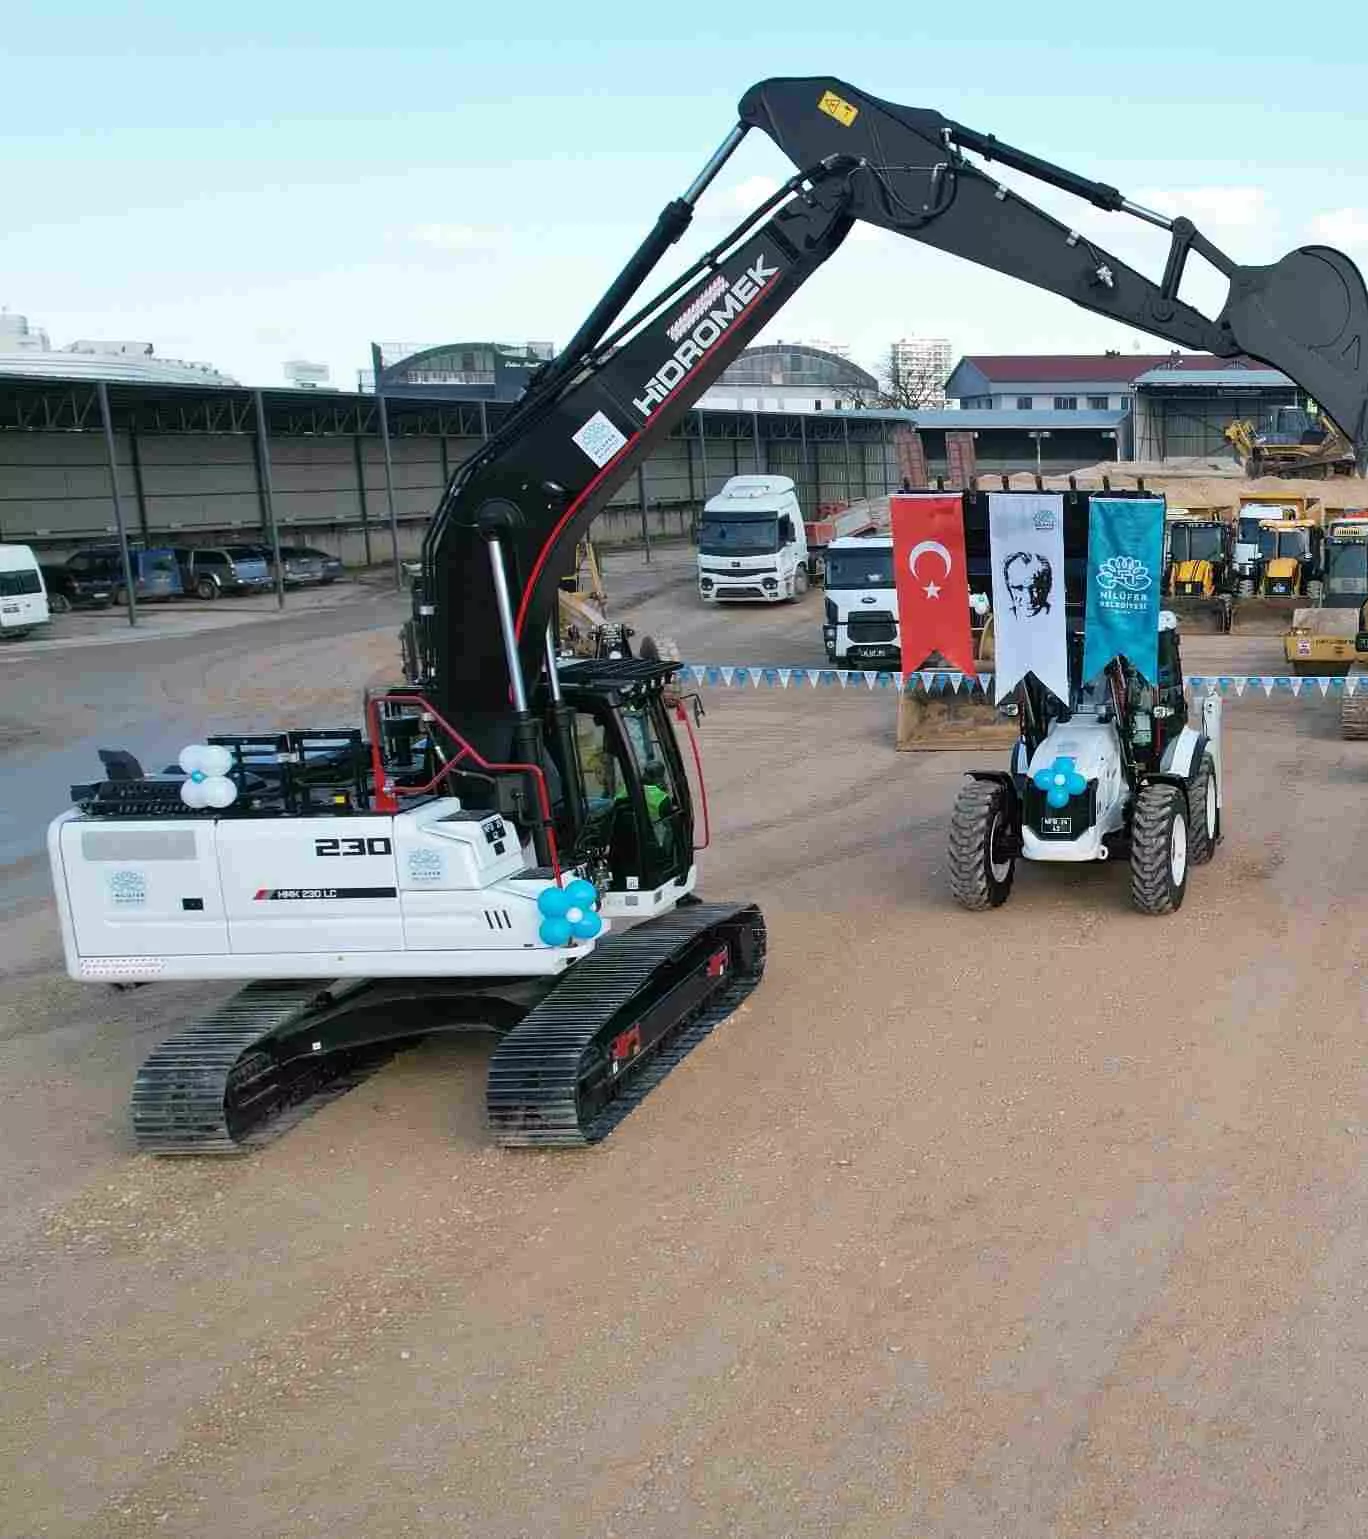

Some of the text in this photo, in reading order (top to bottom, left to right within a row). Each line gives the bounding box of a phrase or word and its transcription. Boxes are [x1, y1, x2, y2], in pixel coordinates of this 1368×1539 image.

[314, 837, 392, 857] 230
[277, 889, 337, 899] HMK 230 LC
